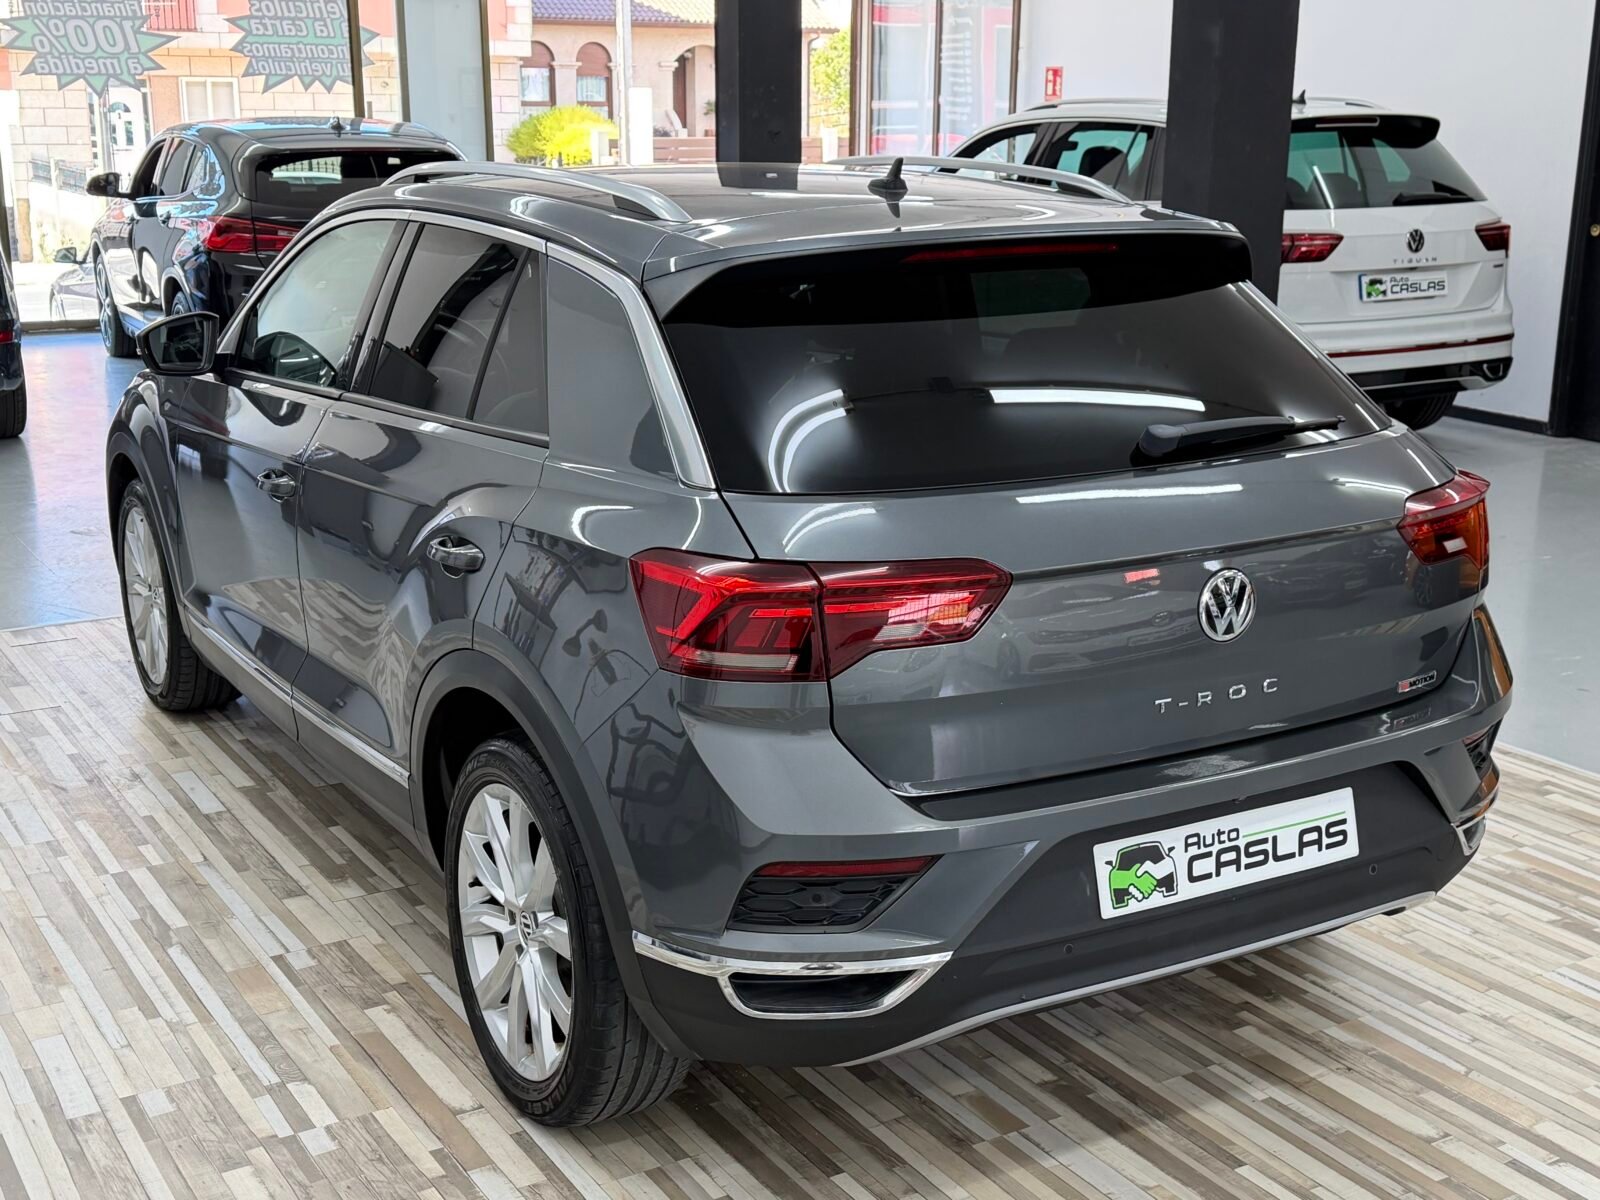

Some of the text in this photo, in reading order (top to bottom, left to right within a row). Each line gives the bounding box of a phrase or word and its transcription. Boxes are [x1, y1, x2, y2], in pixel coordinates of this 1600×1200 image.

[1390, 276, 1410, 284] Auto
[1390, 280, 1446, 294] CASLAS
[1155, 678, 1279, 714] T-ROC
[1184, 828, 1240, 853] Auto
[1187, 818, 1348, 883] CASLAS
